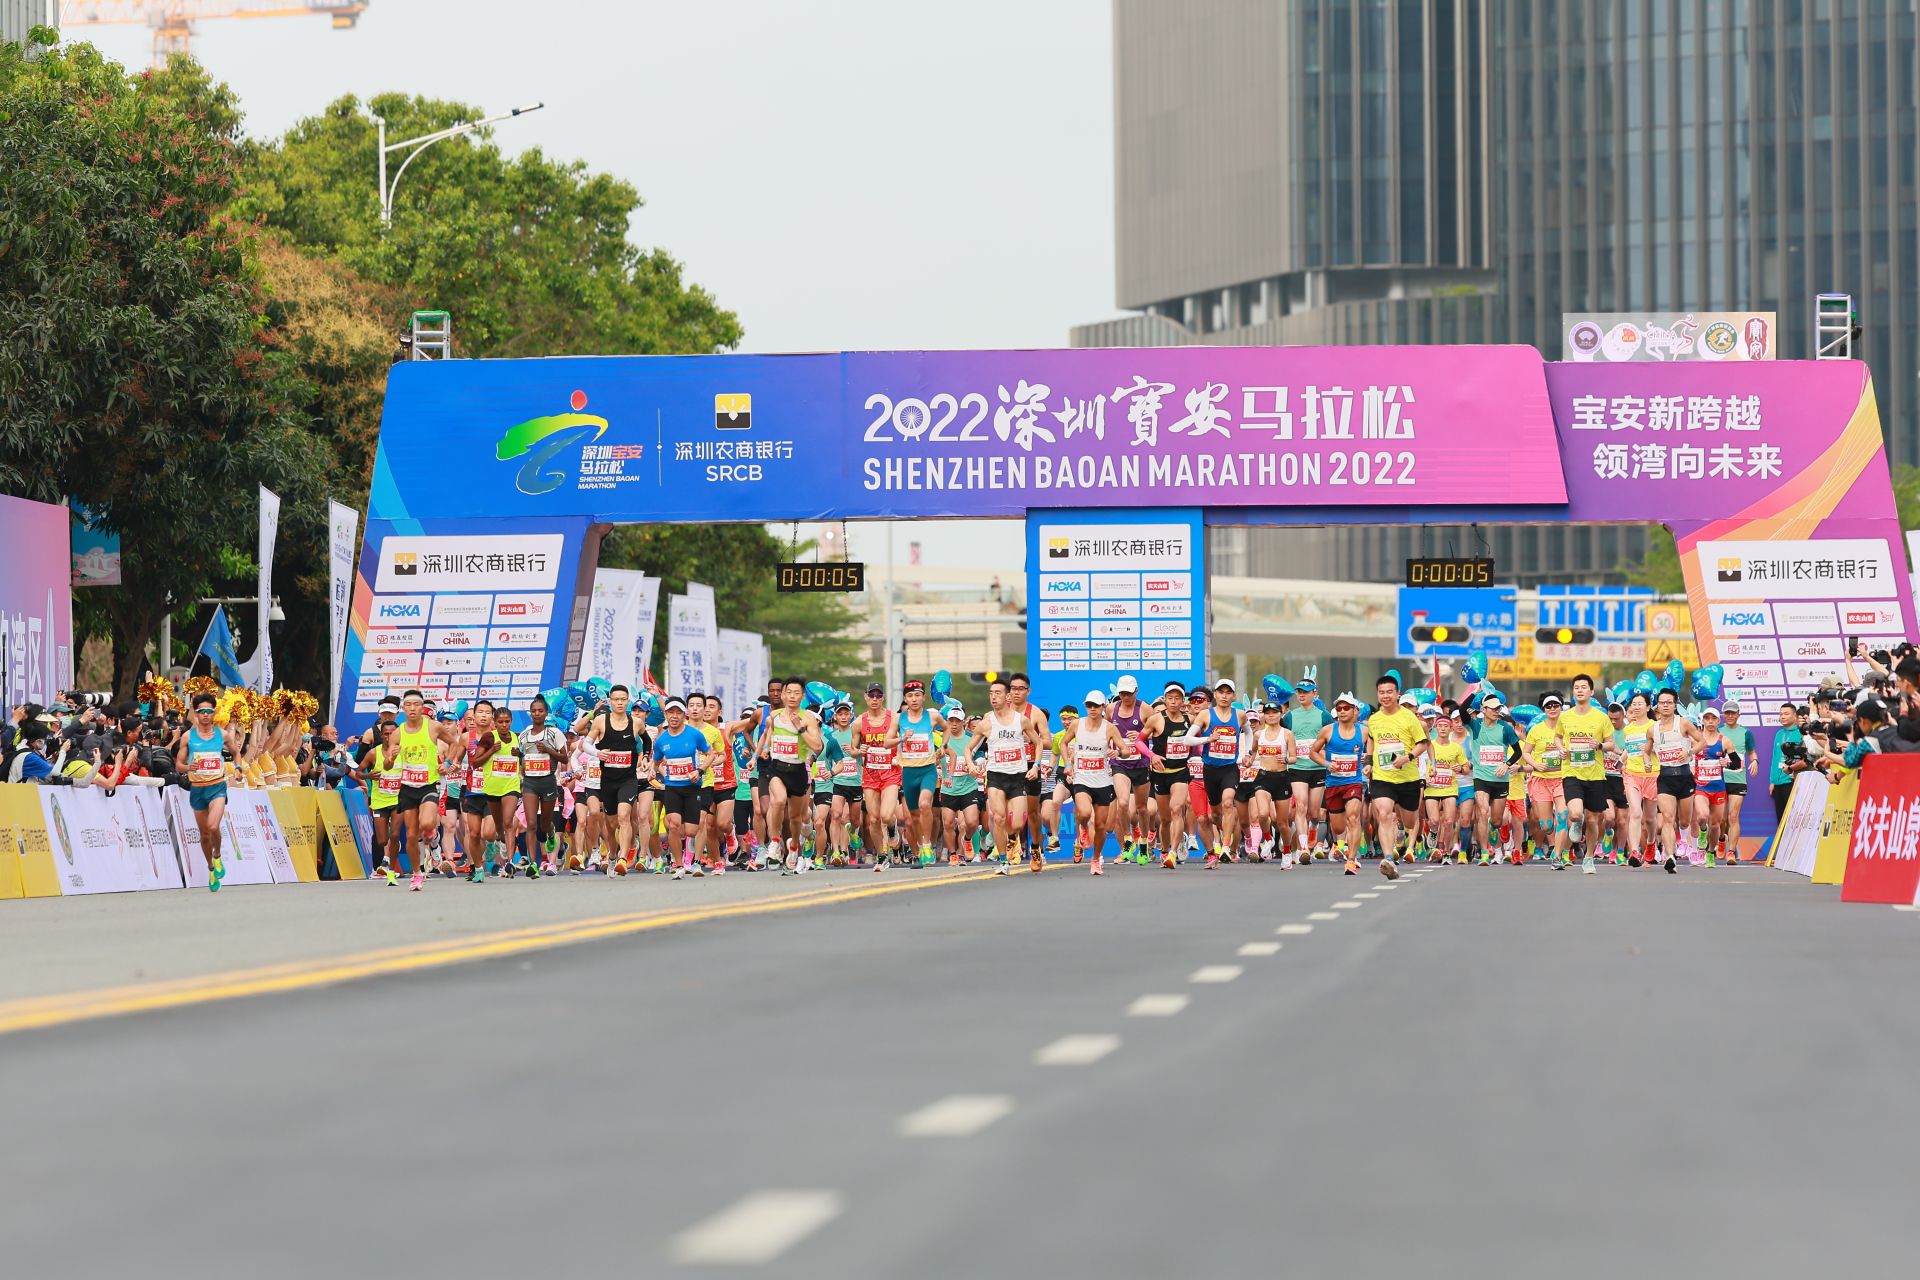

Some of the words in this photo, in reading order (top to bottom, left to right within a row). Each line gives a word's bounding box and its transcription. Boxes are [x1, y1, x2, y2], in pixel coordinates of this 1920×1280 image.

[1571, 395, 1762, 431] 宝安新跨越
[582, 445, 643, 460] 深圳宝安
[675, 441, 793, 461] 深圳农商银行
[579, 460, 625, 475] 马拉松
[1592, 443, 1783, 480] 领湾向未来
[706, 465, 762, 482] SRCB
[863, 456, 1033, 491] SHENZHEN
[1038, 455, 1141, 489] BAOAN
[1148, 453, 1323, 488] MARATHON
[1329, 451, 1416, 486] 2022
[578, 482, 616, 490] MARATHON
[1074, 540, 1182, 556] 深圳农商银行
[423, 553, 546, 573] 深圳农商银行
[1748, 559, 1878, 580] 深圳农商银行
[783, 568, 859, 588] 0:00:05
[1412, 564, 1488, 582] 0:00:05
[1048, 581, 1081, 592] HOKA
[380, 604, 420, 616] HOKA
[1722, 613, 1764, 626] HOKA
[204, 760, 216, 768] 036
